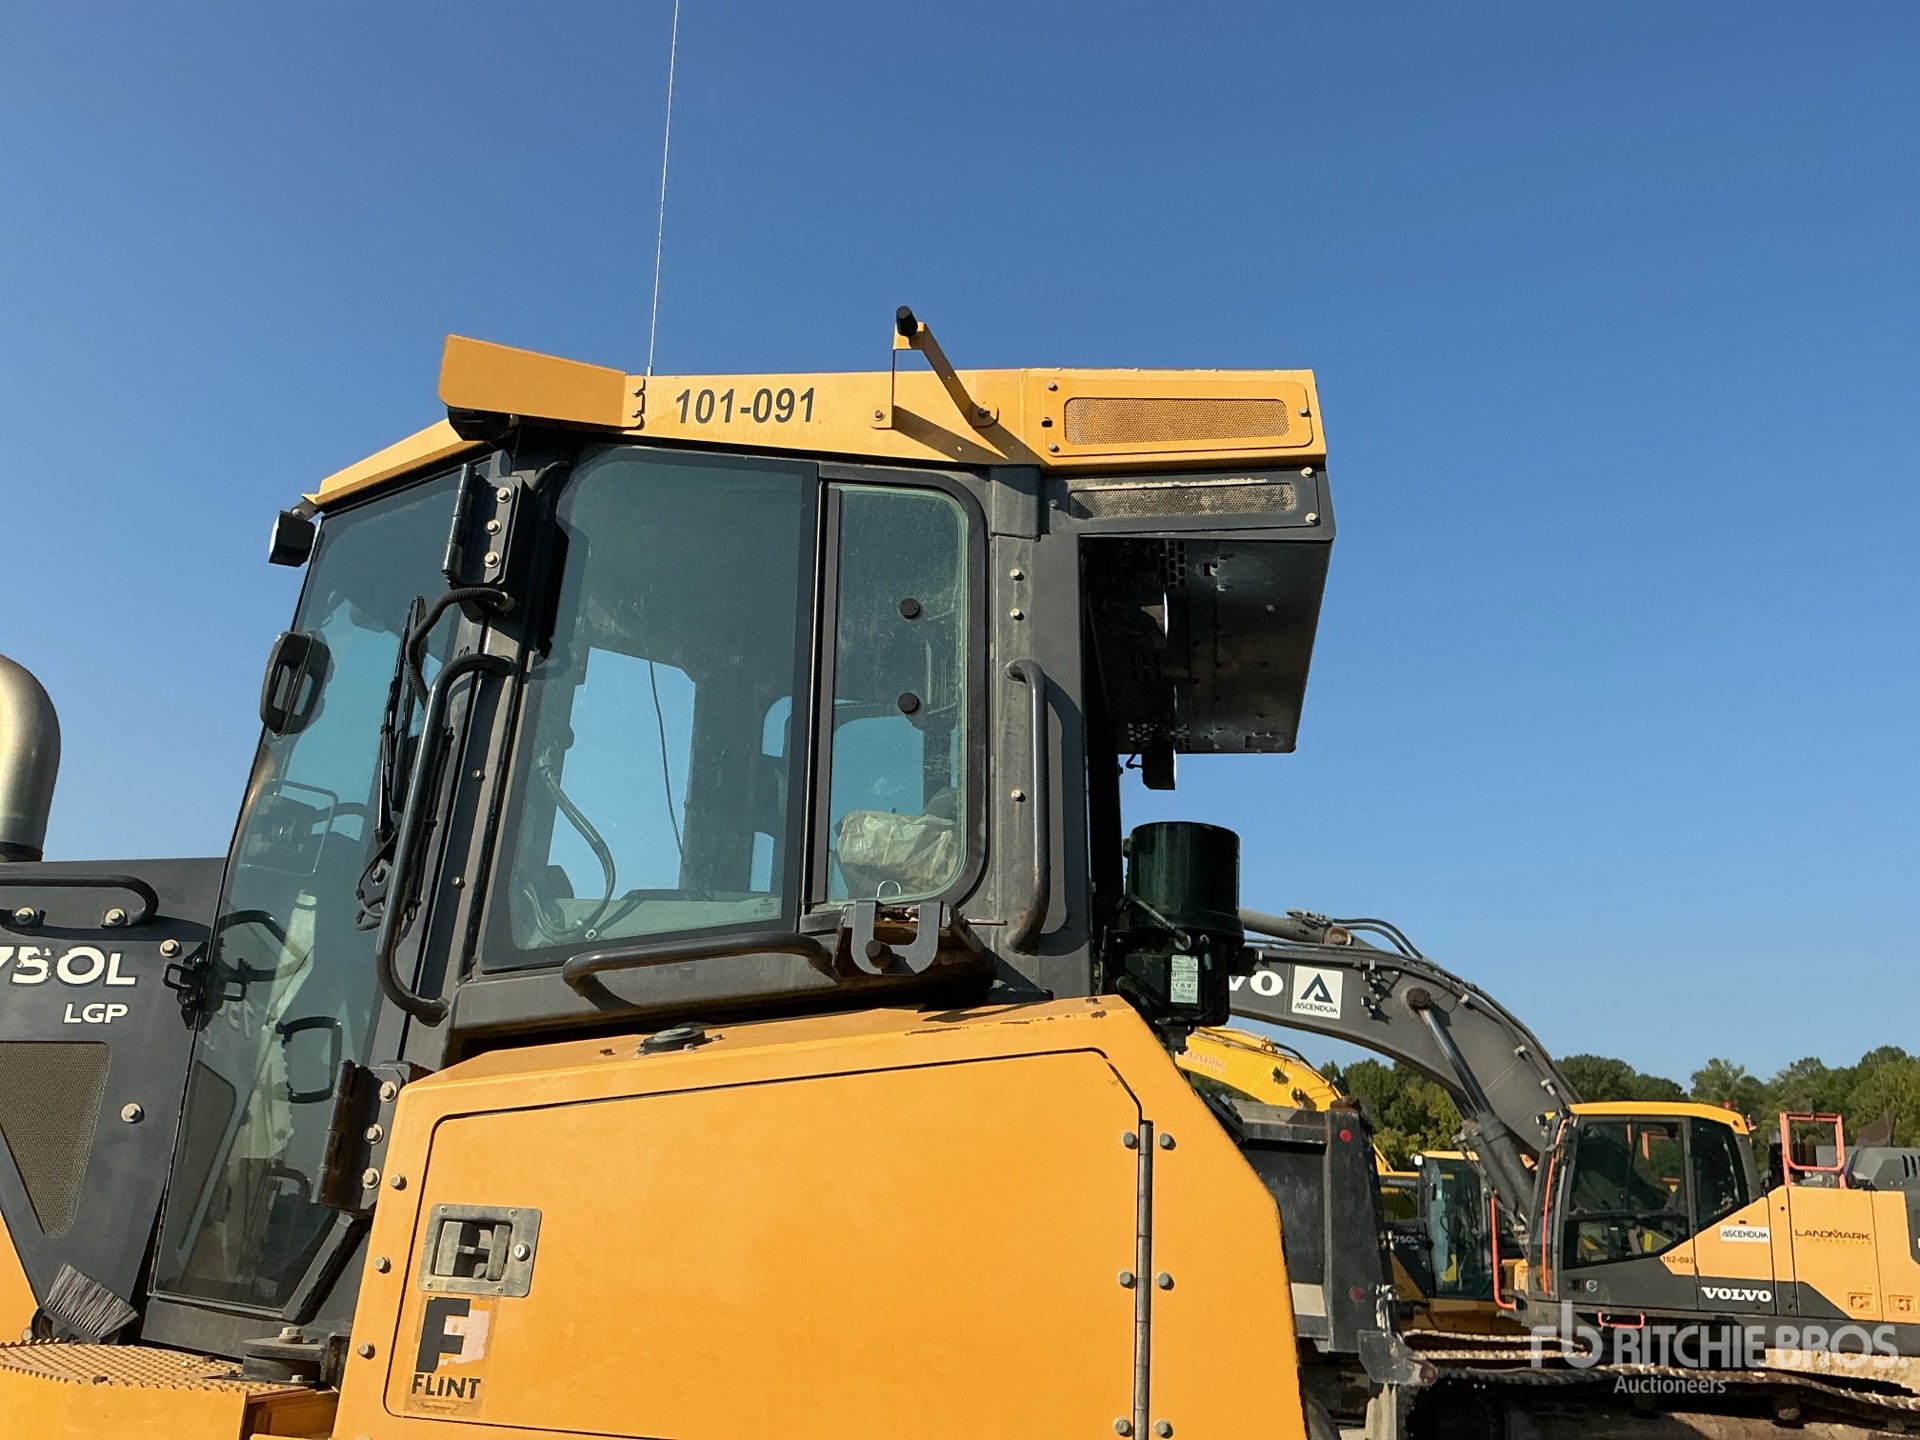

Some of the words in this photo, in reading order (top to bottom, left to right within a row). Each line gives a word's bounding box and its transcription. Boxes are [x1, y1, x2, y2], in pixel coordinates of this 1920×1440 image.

[676, 387, 814, 423] 101-091
[63, 1003, 128, 1024] LGP
[1294, 1001, 1338, 1014] ASCENDUM
[1721, 1229, 1768, 1239] ASCENDUM
[1795, 1229, 1870, 1240] LANDMARK
[1701, 1286, 1773, 1302] VOLVO
[411, 1373, 481, 1399] FLINT
